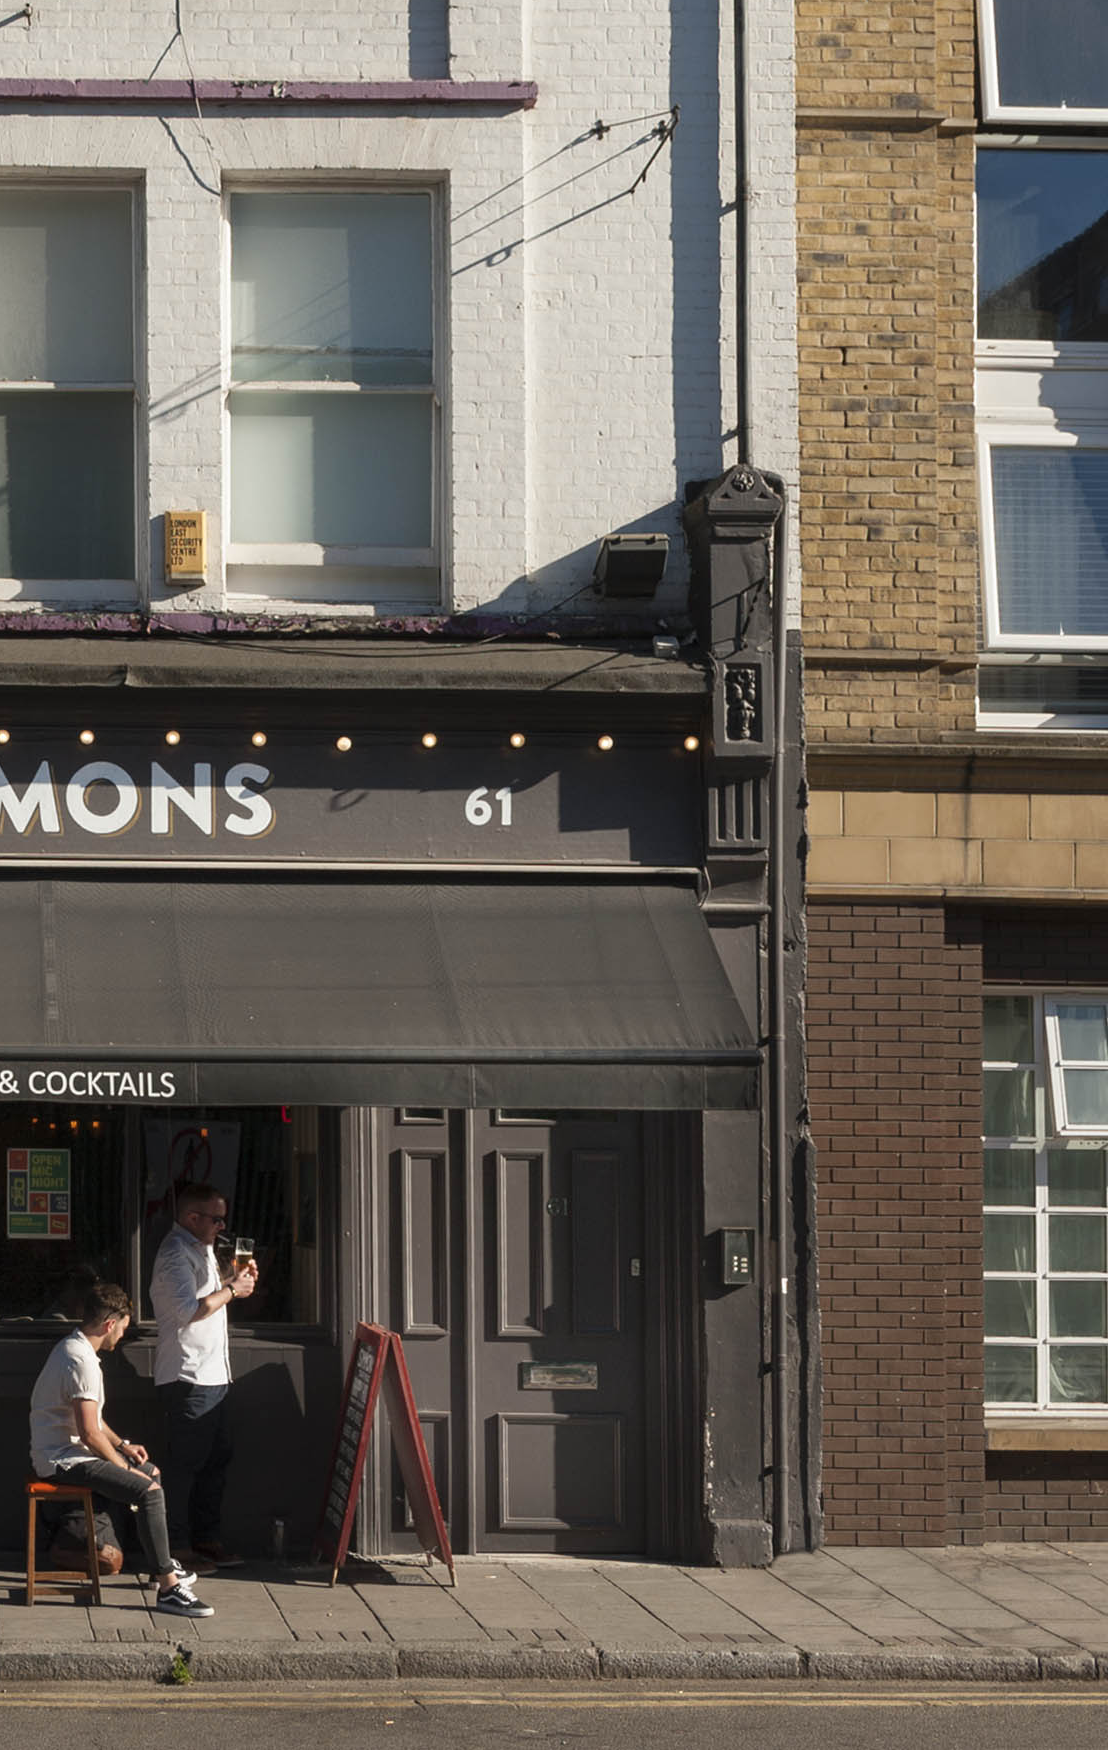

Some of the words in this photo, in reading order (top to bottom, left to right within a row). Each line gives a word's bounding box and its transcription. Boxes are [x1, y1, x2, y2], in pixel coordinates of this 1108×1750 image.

[170, 519, 197, 528] LONDON
[170, 529, 187, 537] EAST
[170, 538, 203, 547] SECURITY
[171, 547, 197, 556] CENTRE
[171, 557, 184, 566] LTD
[464, 787, 512, 826] 61
[29, 1070, 176, 1098] COCKTAILS
[31, 1154, 60, 1165] OPEN
[31, 1166, 52, 1176] MIC
[31, 1177, 65, 1188] NIGHT
